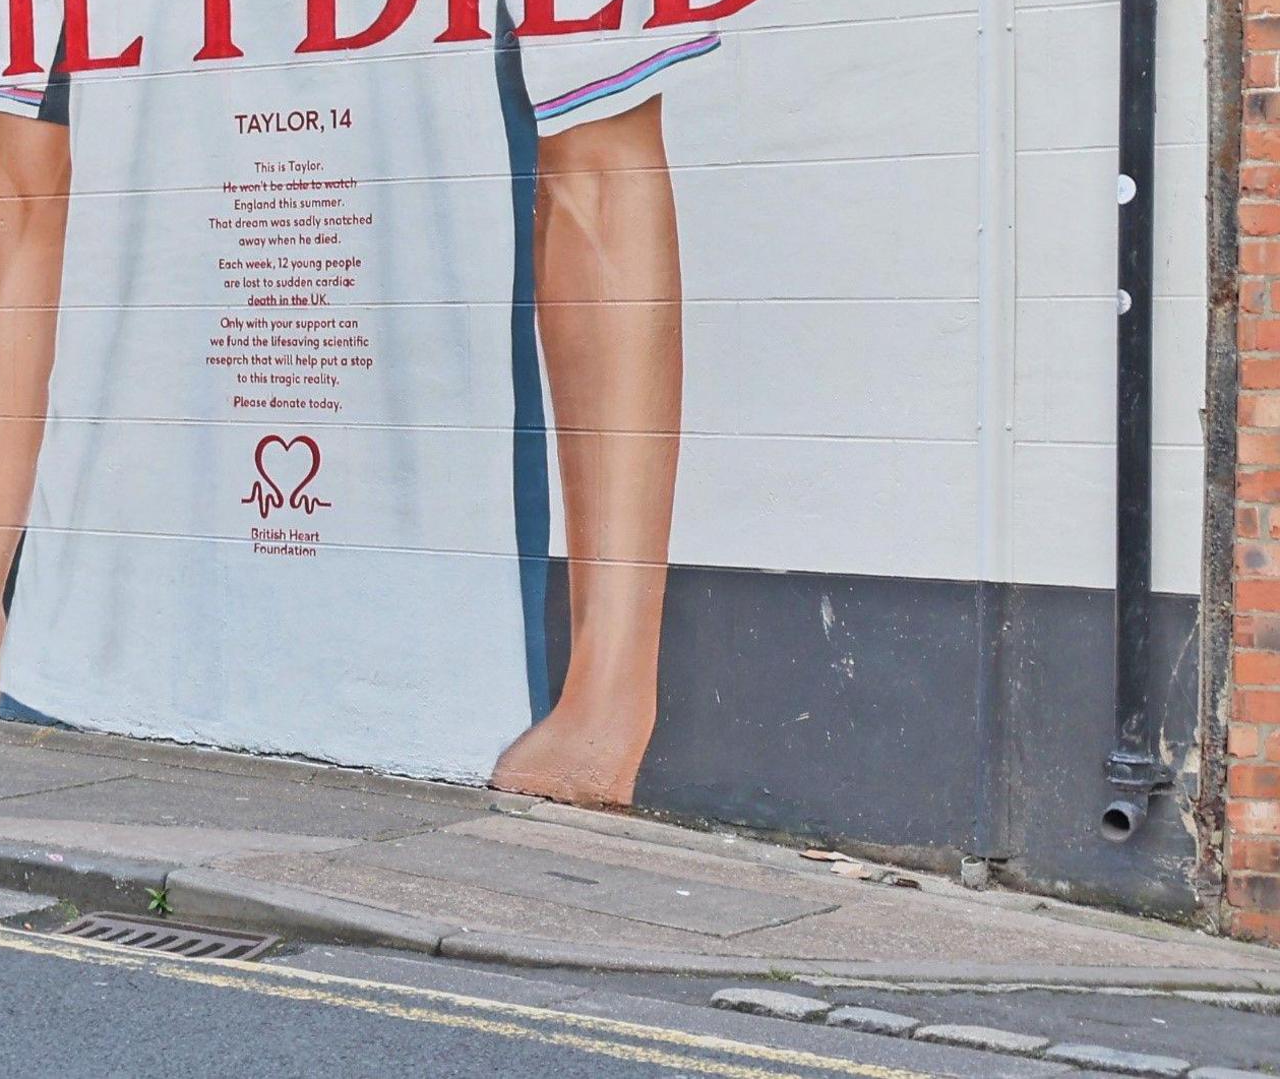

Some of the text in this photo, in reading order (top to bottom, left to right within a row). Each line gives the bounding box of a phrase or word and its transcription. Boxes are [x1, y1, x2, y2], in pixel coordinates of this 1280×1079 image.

[235, 109, 352, 134] TAYLOR, 14
[255, 160, 323, 174] This is Taylor.
[271, 180, 283, 191] be
[312, 179, 321, 190] to
[234, 198, 345, 212] England this summer.
[209, 215, 372, 229] That dream was sadly snatched
[239, 234, 341, 248] away when he died.
[219, 258, 361, 271] Each week, 12 young people
[224, 277, 354, 289] are lost to sudden cardiac
[248, 294, 330, 306] death in the UK.
[221, 318, 357, 331] Only with your support can
[210, 336, 368, 349] we fund the lifesaving scientific
[251, 355, 272, 366] that
[275, 355, 293, 366] will
[296, 356, 317, 368] help
[321, 356, 338, 368] put
[341, 357, 348, 366] a
[351, 356, 372, 368] stop
[238, 373, 339, 386] to this tragic reality.
[234, 396, 343, 412] Please donate today.
[251, 528, 320, 542] British Heart
[254, 543, 316, 557] Foundation
